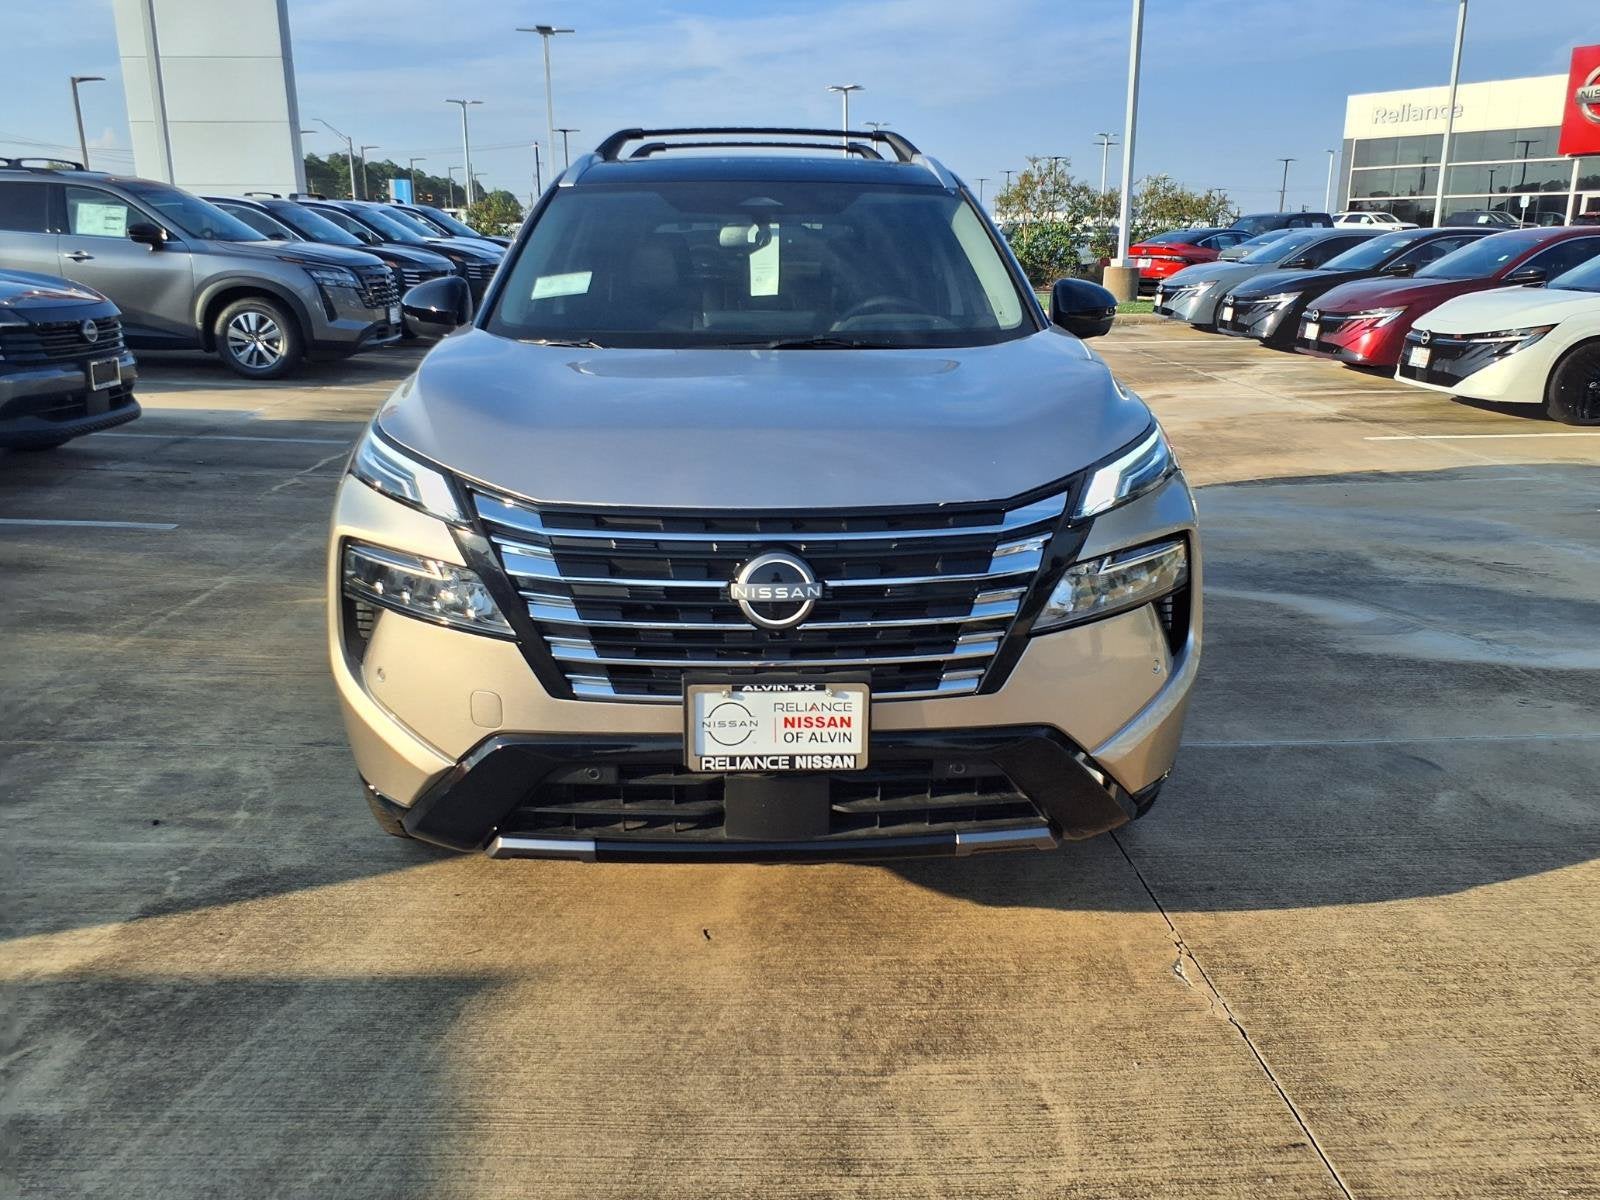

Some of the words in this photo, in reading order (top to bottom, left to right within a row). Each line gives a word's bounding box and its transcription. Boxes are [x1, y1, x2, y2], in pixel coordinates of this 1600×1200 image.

[1373, 104, 1463, 124] Reliance
[734, 587, 820, 598] NISSAN
[774, 702, 853, 713] RELIANCE
[702, 720, 759, 728] NISSAN
[783, 716, 852, 728] NISSAN
[783, 732, 804, 743] OF
[808, 732, 852, 743] ALVIN
[701, 756, 790, 770] RELIANCE
[795, 755, 855, 769] NISSAN
